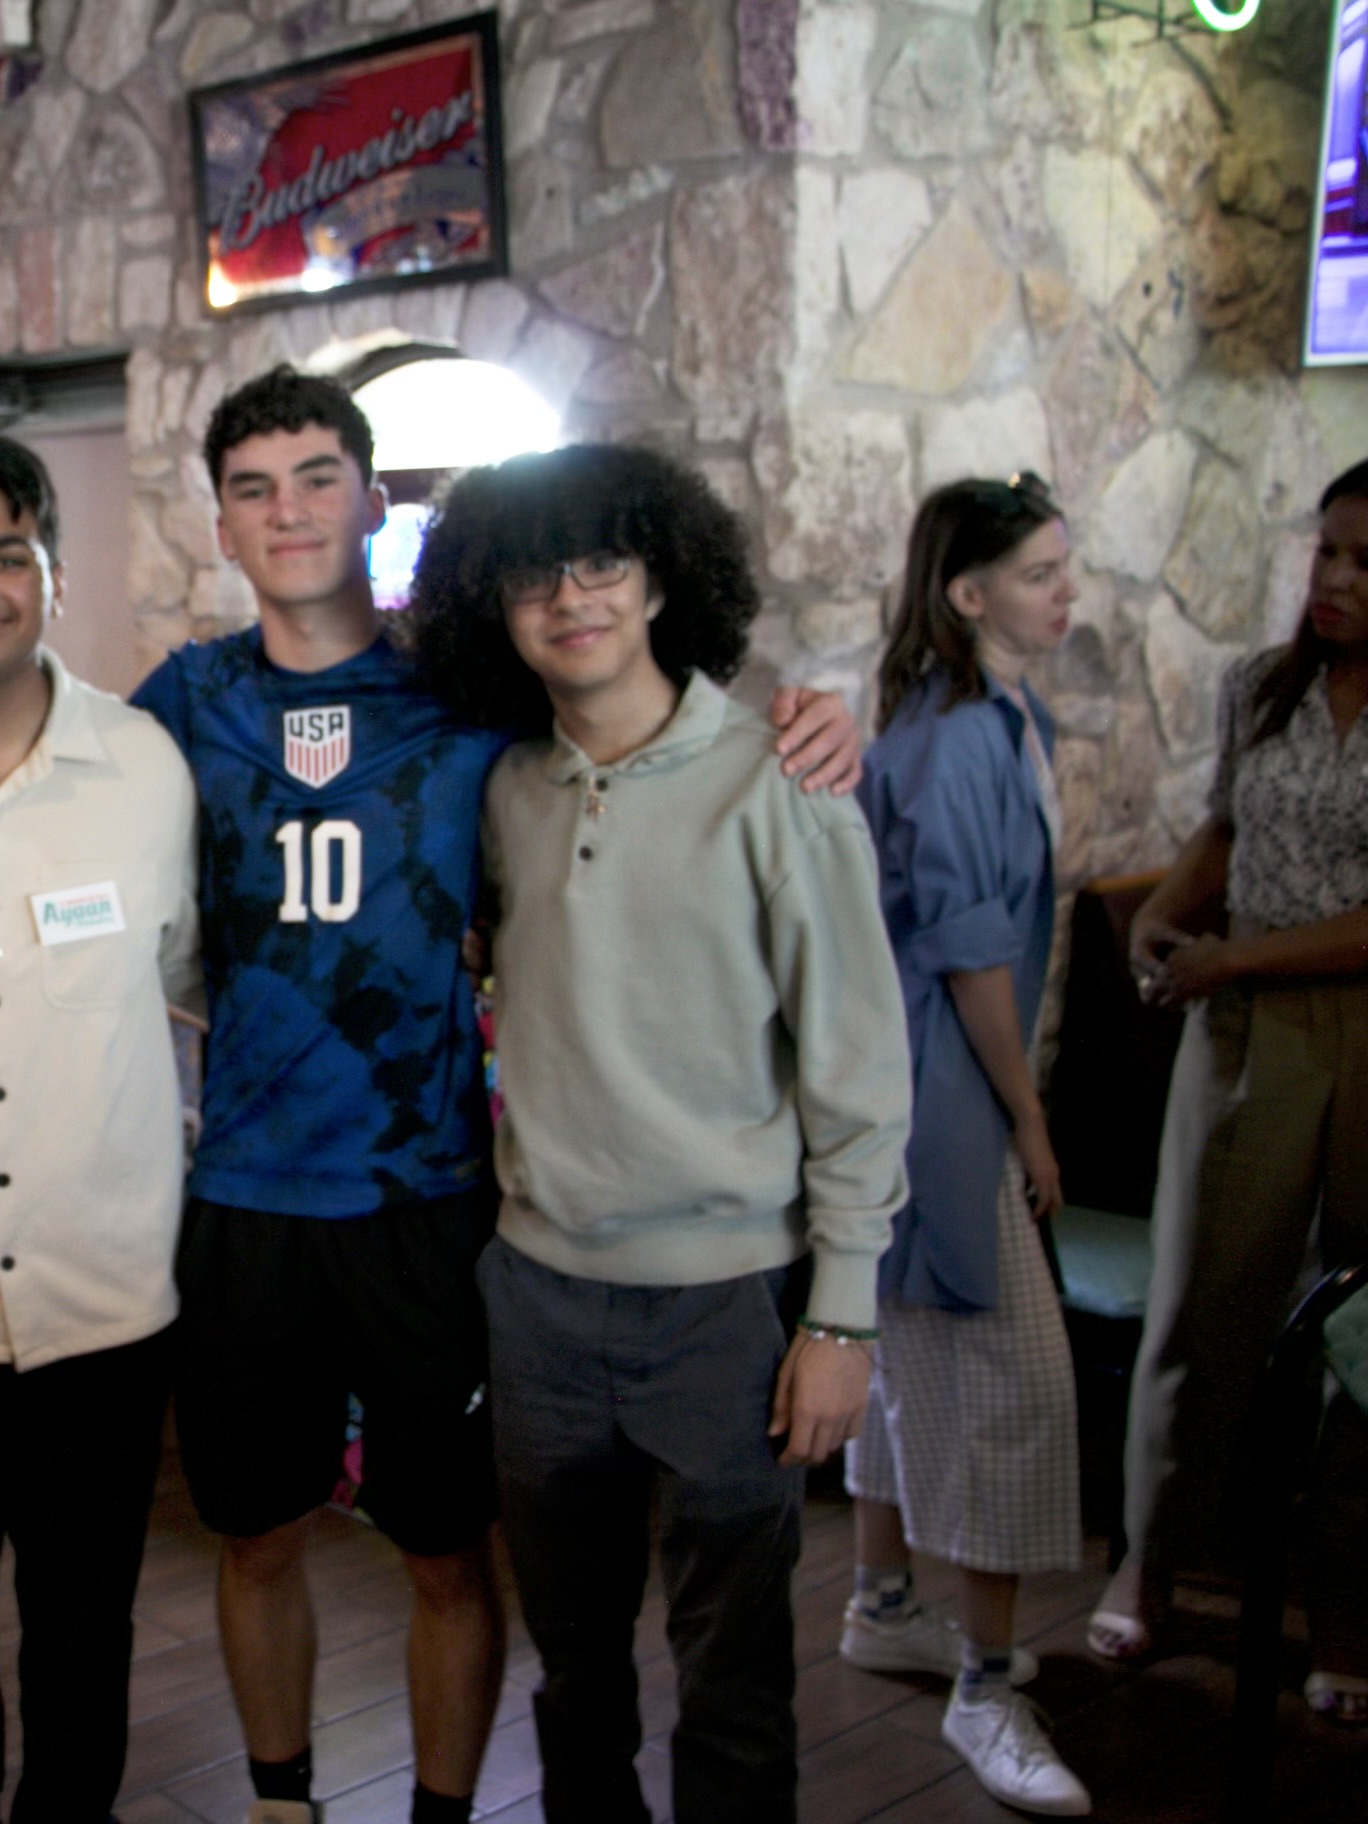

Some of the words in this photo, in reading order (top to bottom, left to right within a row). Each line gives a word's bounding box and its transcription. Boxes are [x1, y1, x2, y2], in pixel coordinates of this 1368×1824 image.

[209, 93, 475, 256] Budweiser
[289, 711, 344, 742] USA
[275, 820, 362, 922] 10
